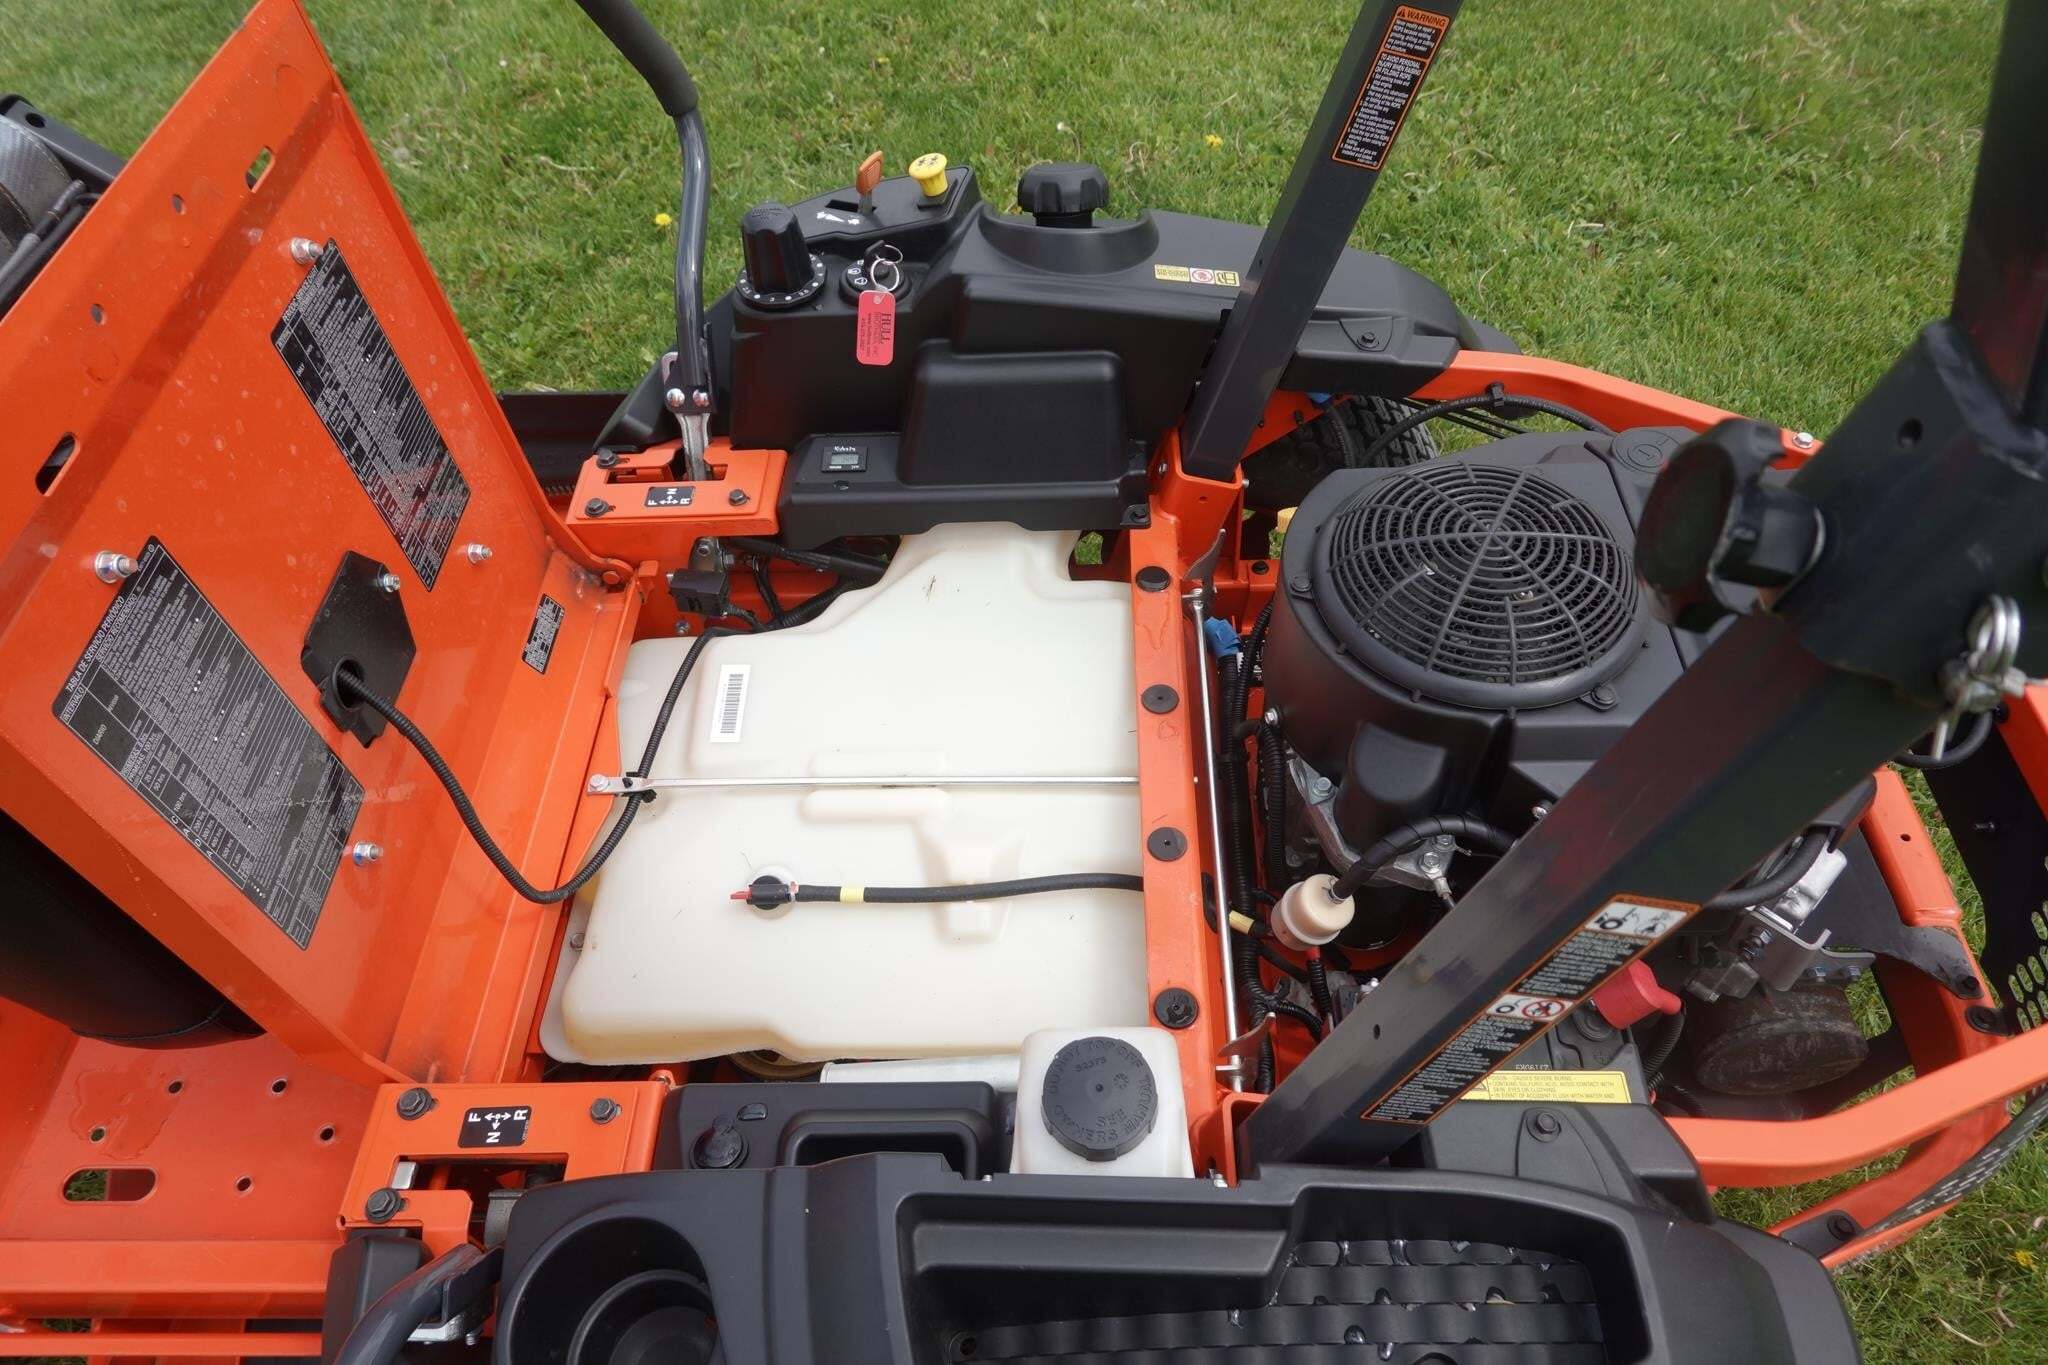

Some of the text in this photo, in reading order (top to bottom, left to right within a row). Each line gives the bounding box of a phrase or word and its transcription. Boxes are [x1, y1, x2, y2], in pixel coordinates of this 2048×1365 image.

[1406, 9, 1446, 27] WARNING
[96, 591, 138, 664] SERVICIO RECOMENDADO
[83, 626, 105, 663] SERVICIO
[78, 658, 89, 673] DE
[66, 668, 84, 694] TABLA
[62, 685, 84, 722] INTERVALO
[92, 722, 107, 746] DIARIO
[172, 798, 183, 814] 100
[468, 1112, 482, 1122] F
[514, 1110, 528, 1120] R
[486, 1132, 501, 1144] N
